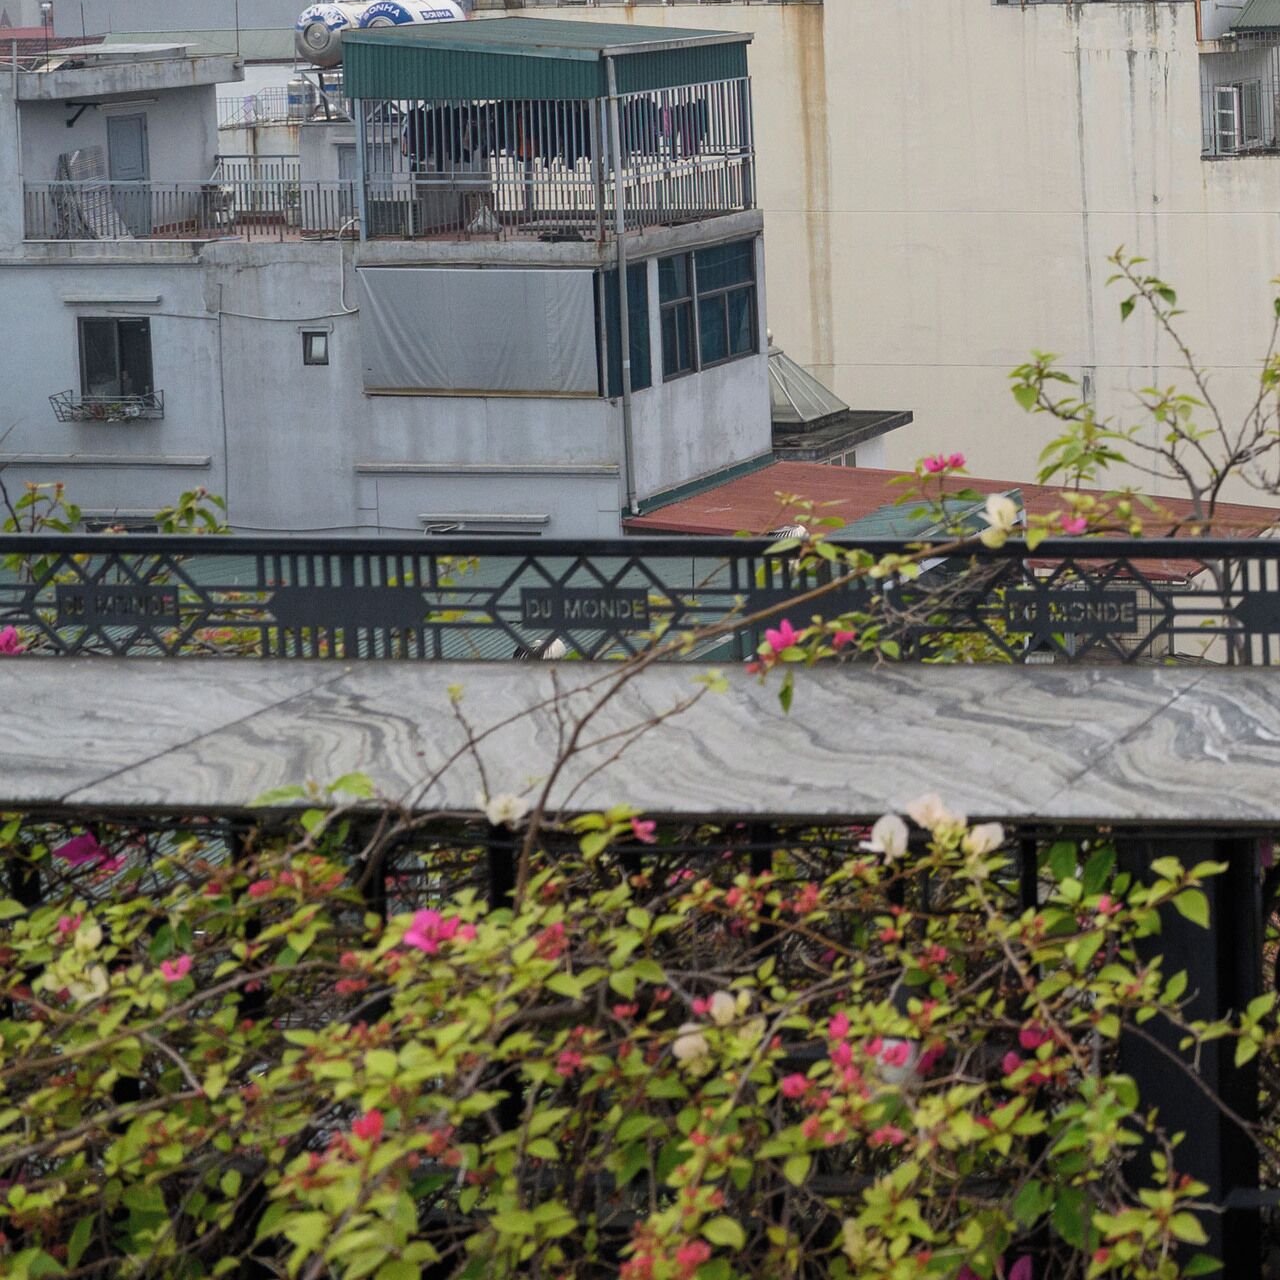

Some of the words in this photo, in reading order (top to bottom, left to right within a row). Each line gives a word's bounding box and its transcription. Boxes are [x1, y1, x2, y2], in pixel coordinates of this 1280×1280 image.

[526, 599, 553, 618] DU
[564, 599, 647, 619] MONDE
[1048, 601, 1135, 622] MONDE
